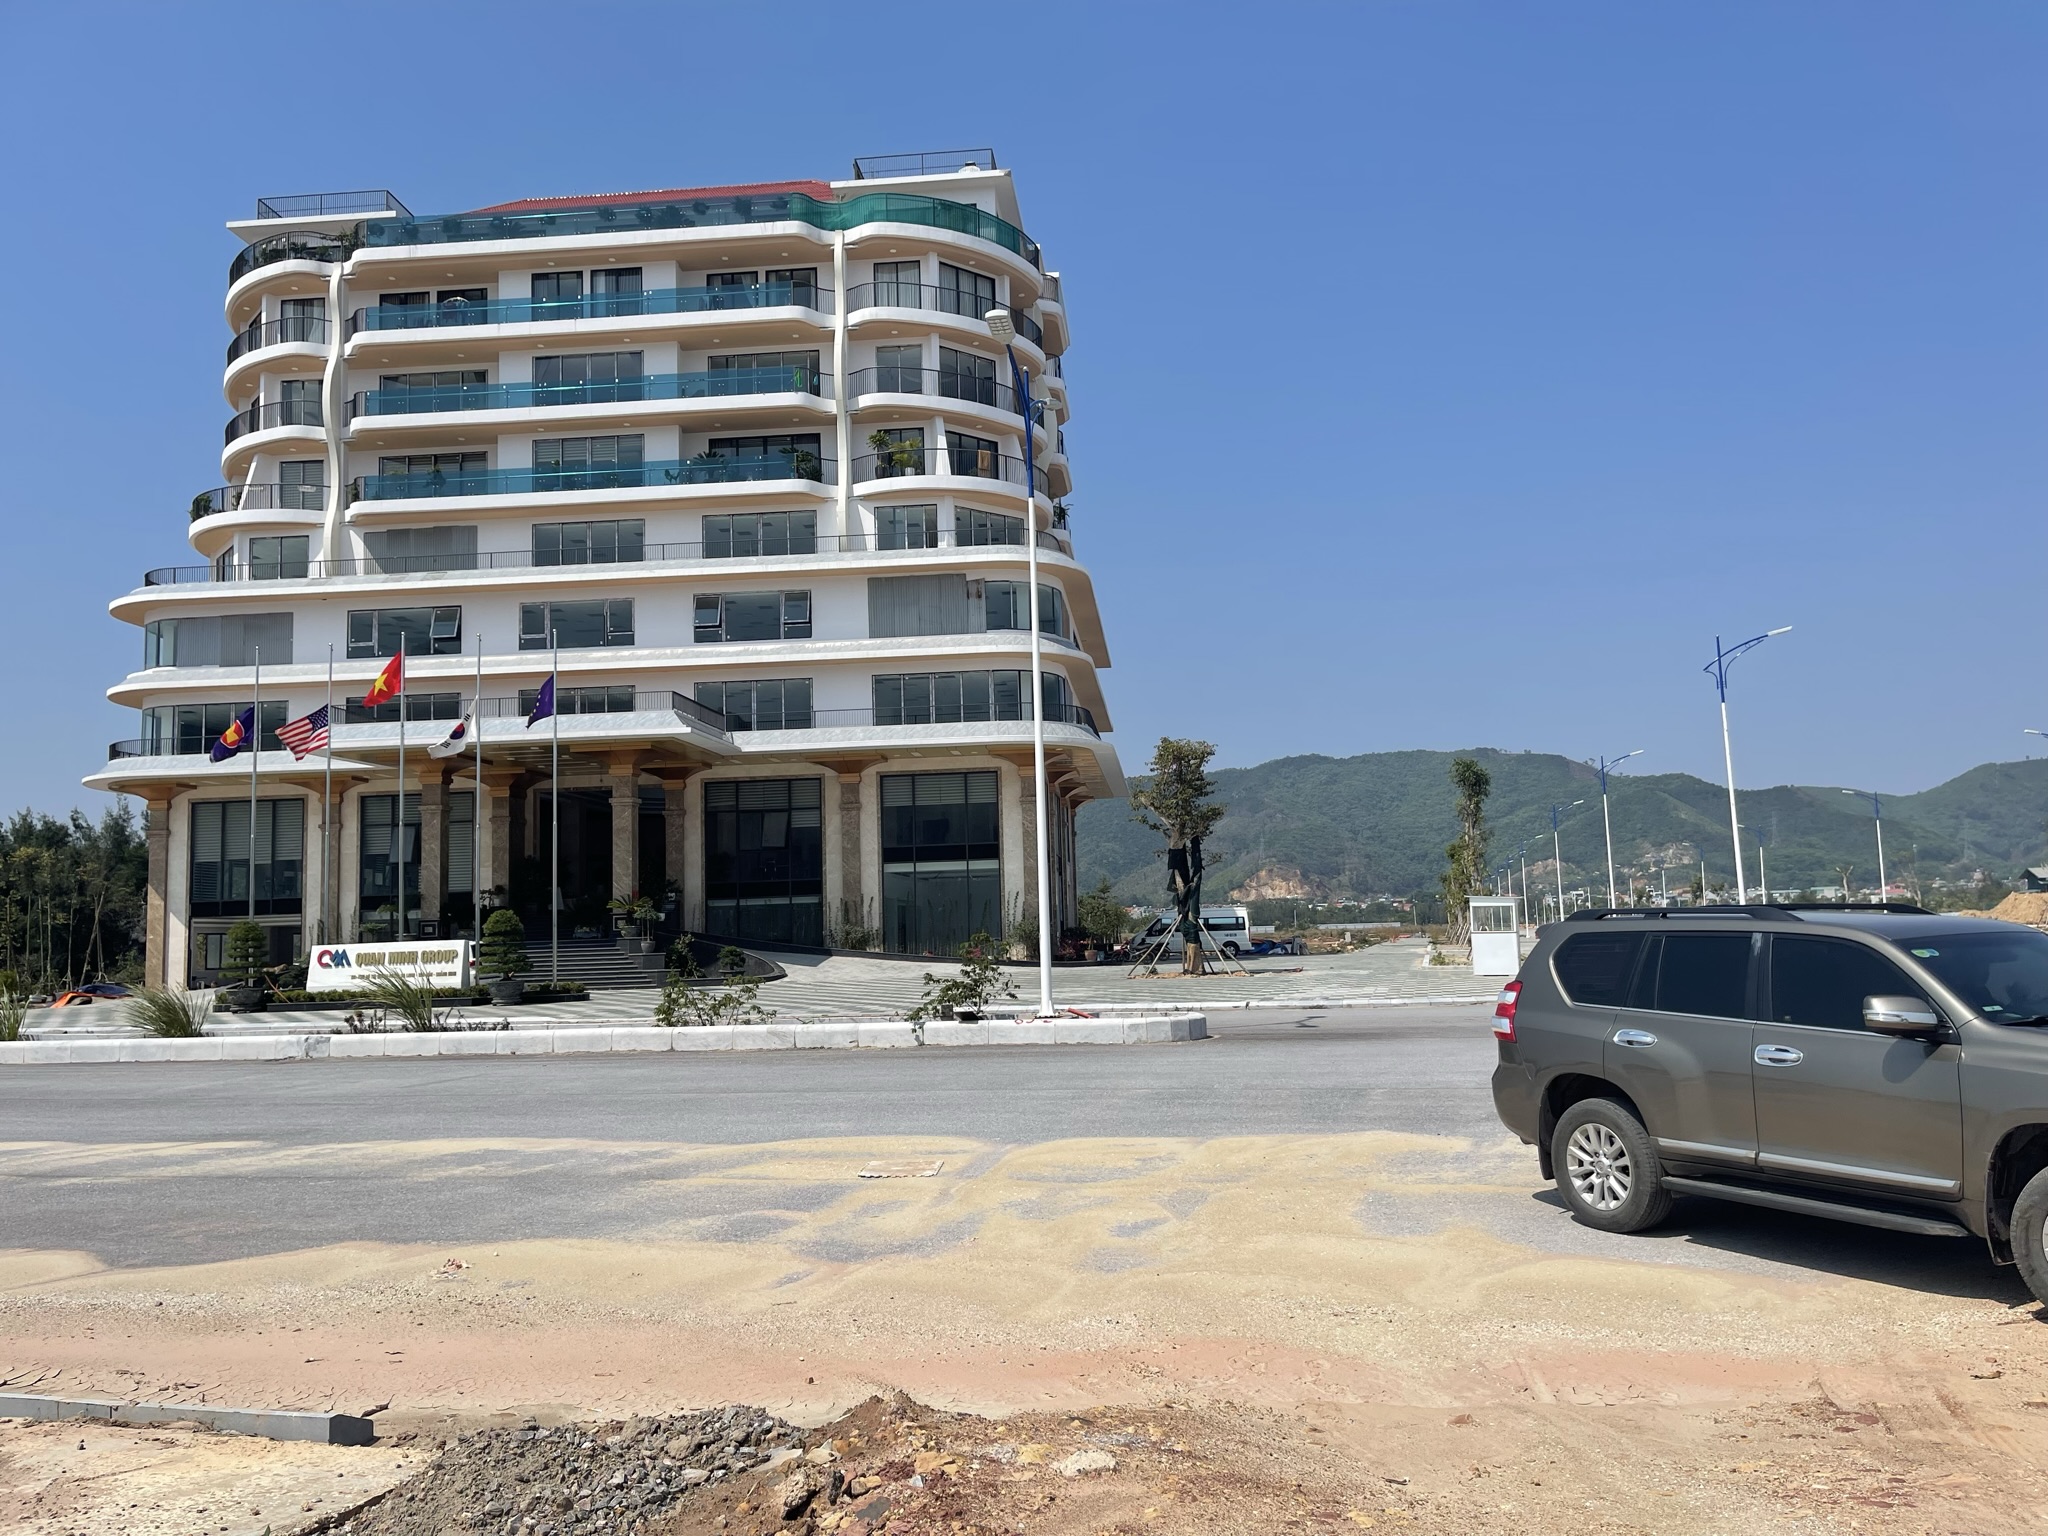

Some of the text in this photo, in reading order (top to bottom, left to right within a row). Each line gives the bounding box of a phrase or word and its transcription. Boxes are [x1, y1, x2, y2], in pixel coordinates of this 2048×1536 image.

[355, 949, 458, 967] QUAN MINH GROUP
